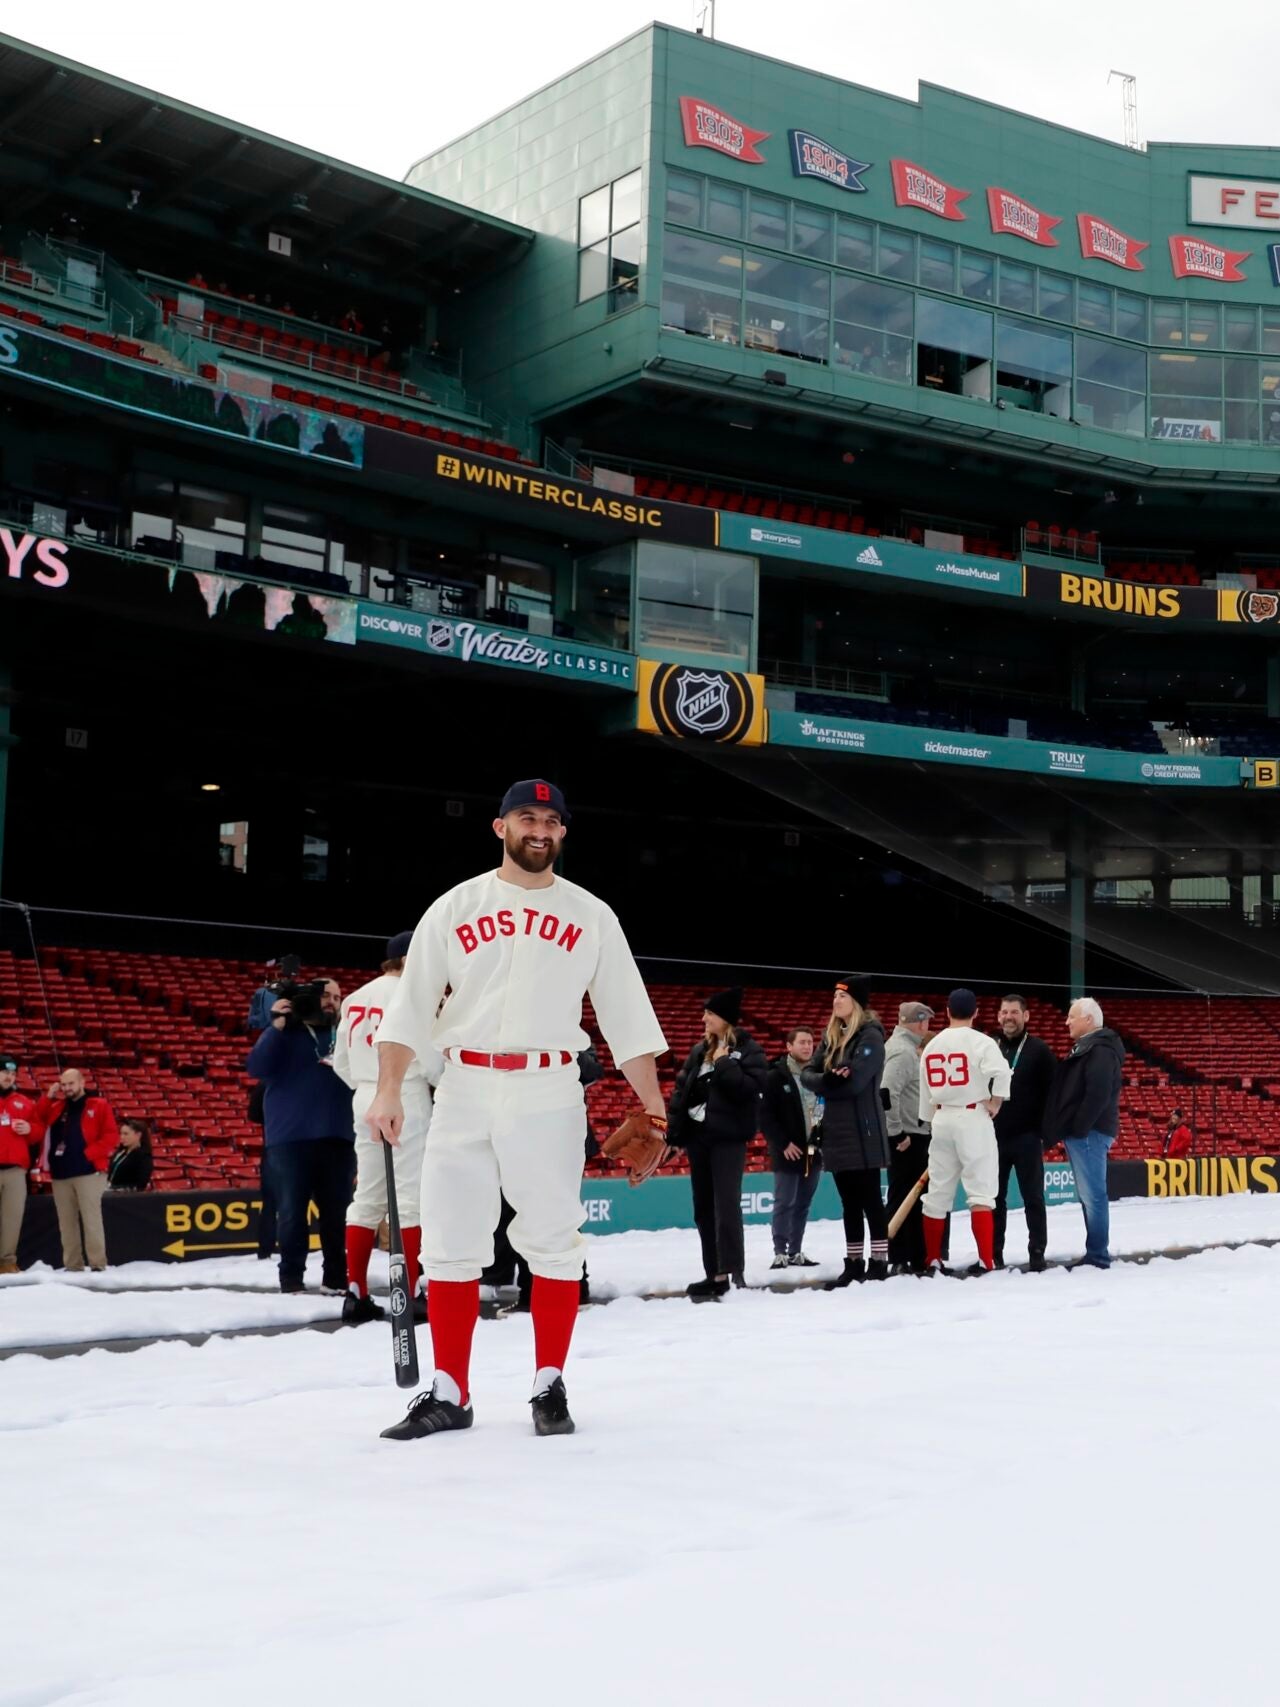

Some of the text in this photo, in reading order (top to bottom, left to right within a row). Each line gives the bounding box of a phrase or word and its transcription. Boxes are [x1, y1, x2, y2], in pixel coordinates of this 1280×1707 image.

[695, 112, 744, 149] 1903
[698, 132, 740, 155] CHAMPIONS
[803, 144, 848, 180] 1904
[806, 163, 845, 185] CHAMPIONS
[907, 174, 945, 206] 1912
[908, 192, 944, 213] CHAMPIONS
[1001, 201, 1039, 233] 1915
[1003, 218, 1038, 239] CHAMPIONS
[1092, 227, 1127, 258] 1916
[1093, 245, 1126, 264] CHAMPIONS
[1184, 246, 1225, 271] 1918
[1186, 263, 1224, 277] CHAMPIONS
[437, 455, 662, 527] #WINTERCLASSIC
[0, 528, 69, 588] YS
[857, 555, 883, 567] adidas
[946, 563, 1000, 581] MassMutual
[1061, 573, 1181, 617] BRUINS
[360, 614, 422, 639] DISCOVER
[455, 623, 551, 670] Winter
[554, 653, 630, 678] CLASSIC
[688, 688, 720, 718] NHL
[802, 719, 865, 737] DRAFTKINGS
[816, 735, 865, 748] SPORTSBOOK
[924, 741, 988, 759] ticketmaster
[1049, 751, 1085, 764] TRULY
[1153, 764, 1200, 773] NAVY FEDERAL
[1153, 771, 1201, 779] CREDIT UNION
[536, 784, 550, 802] B
[455, 908, 583, 954] BOSTON
[925, 1053, 970, 1087] 63
[1144, 1156, 1279, 1197] BRUINS
[400, 1328, 410, 1367] SLUGGER
